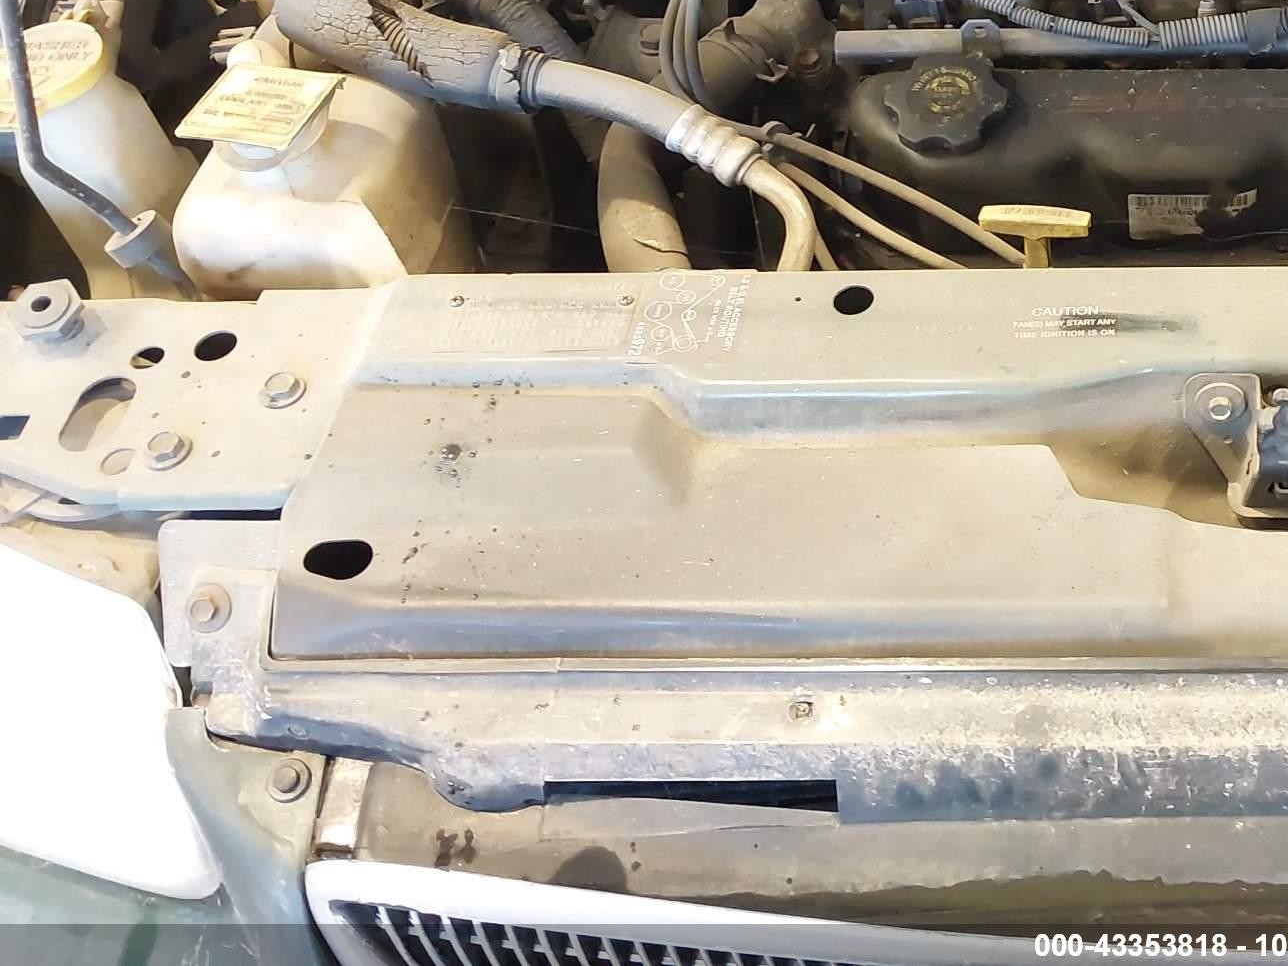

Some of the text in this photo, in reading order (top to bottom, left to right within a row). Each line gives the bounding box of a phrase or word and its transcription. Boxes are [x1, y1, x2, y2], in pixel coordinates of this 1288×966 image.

[1031, 305, 1099, 317] CAUTION
[1012, 320, 1043, 328] FAN(S)
[1066, 319, 1096, 327] START
[1040, 330, 1085, 338] IGNITION
